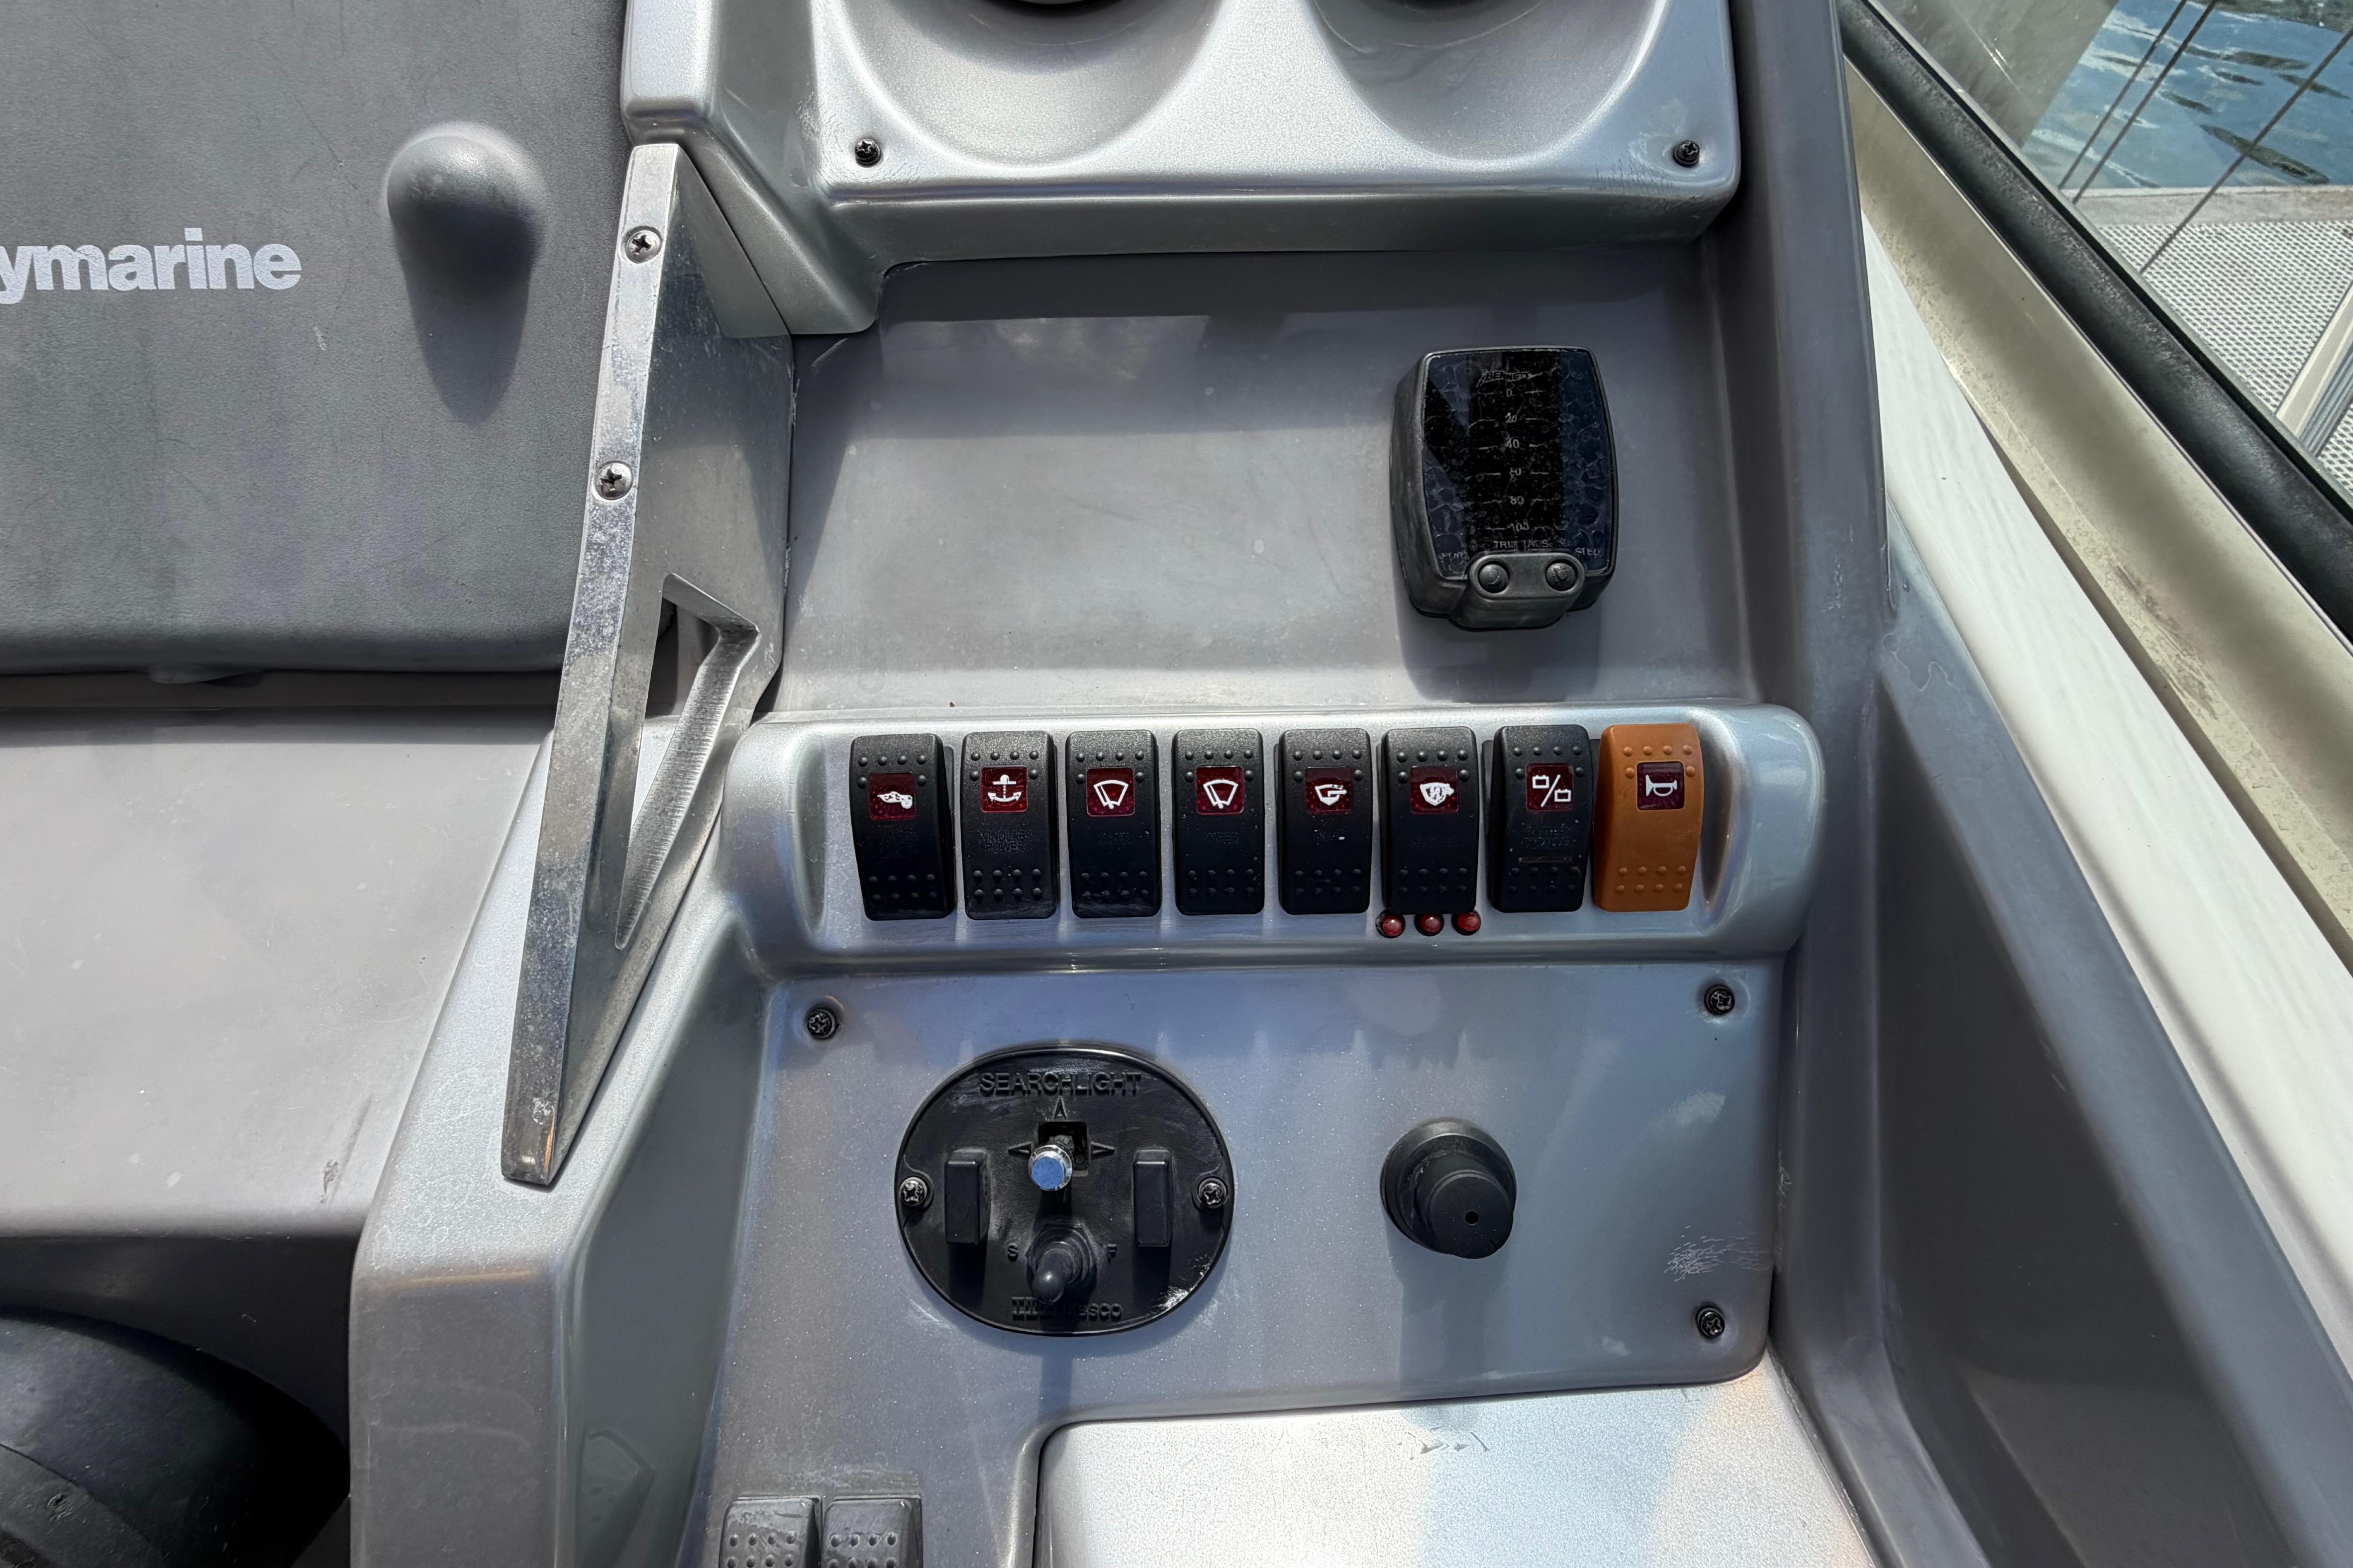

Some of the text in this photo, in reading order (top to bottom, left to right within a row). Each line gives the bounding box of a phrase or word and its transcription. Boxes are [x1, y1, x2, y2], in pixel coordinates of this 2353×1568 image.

[0, 227, 302, 304] ymarine
[1506, 389, 1513, 397] 0
[1505, 413, 1518, 423] 20
[1505, 438, 1520, 449] 40
[1510, 496, 1525, 505] 80
[1510, 522, 1530, 531] 100
[979, 1072, 1142, 1095] SEARCHLIGHT
[1007, 1242, 1019, 1260] S
